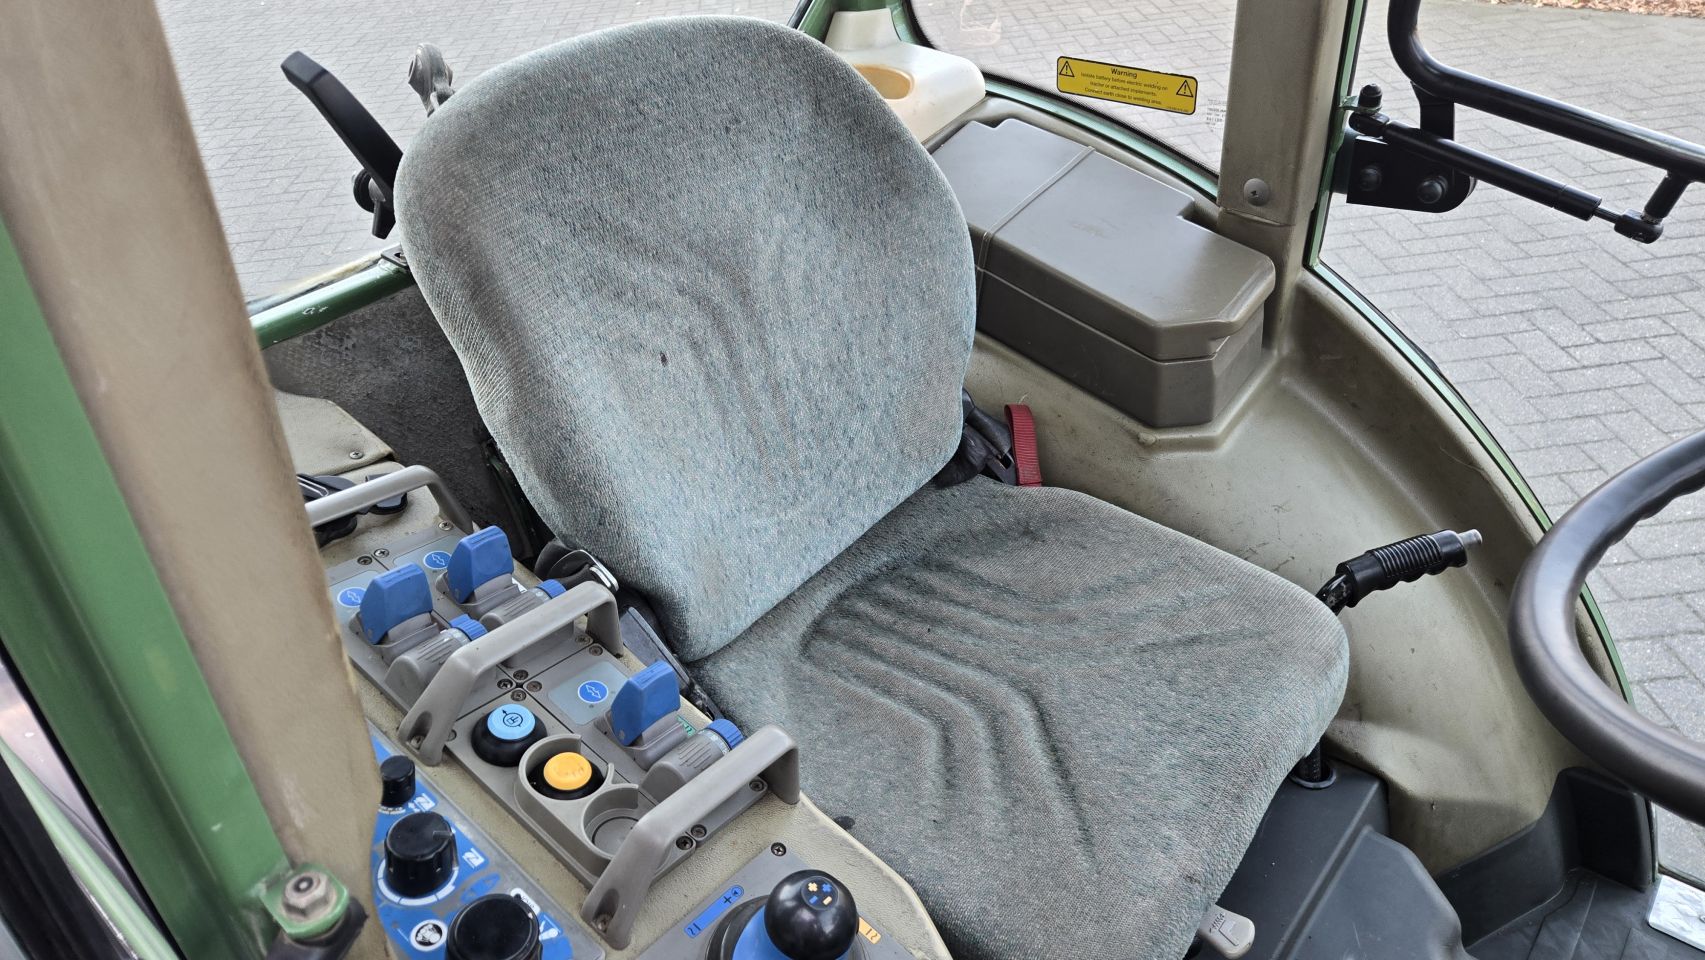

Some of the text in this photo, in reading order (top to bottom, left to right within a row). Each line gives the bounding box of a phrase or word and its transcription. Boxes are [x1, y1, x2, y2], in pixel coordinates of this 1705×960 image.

[1110, 68, 1138, 79] Warning
[1144, 81, 1162, 90] welding
[1133, 96, 1151, 104] welding
